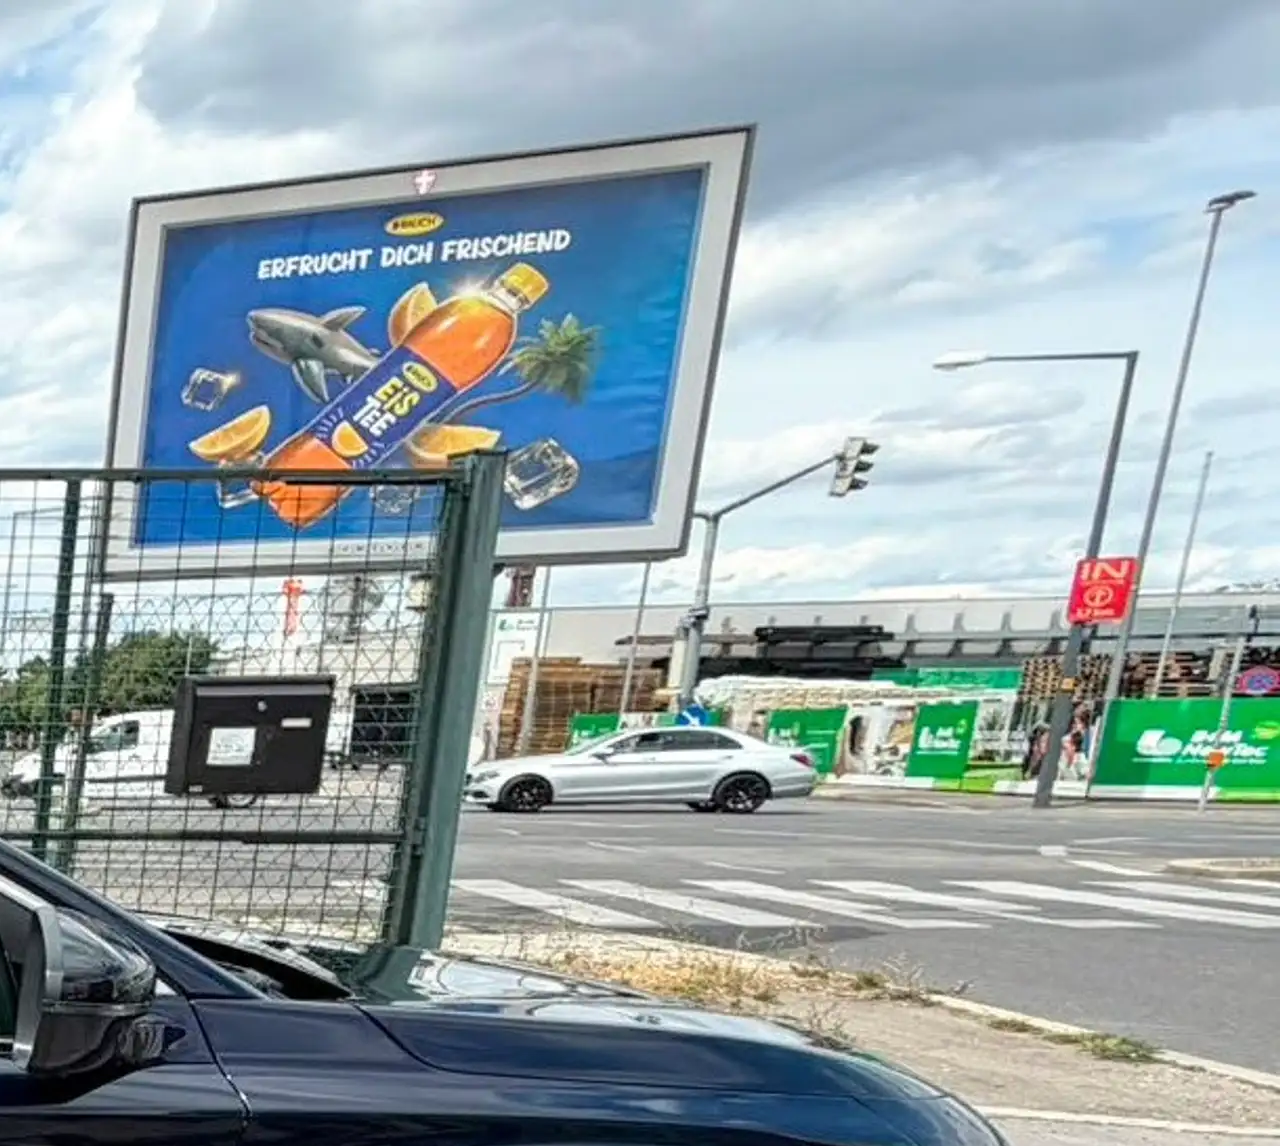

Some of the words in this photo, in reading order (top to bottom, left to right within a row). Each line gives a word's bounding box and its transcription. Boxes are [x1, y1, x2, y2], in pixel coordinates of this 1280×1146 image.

[257, 248, 373, 280] ERFRUCHT
[380, 241, 435, 268] DICH
[440, 228, 571, 262] FRISCHEND
[353, 395, 397, 437] TEE
